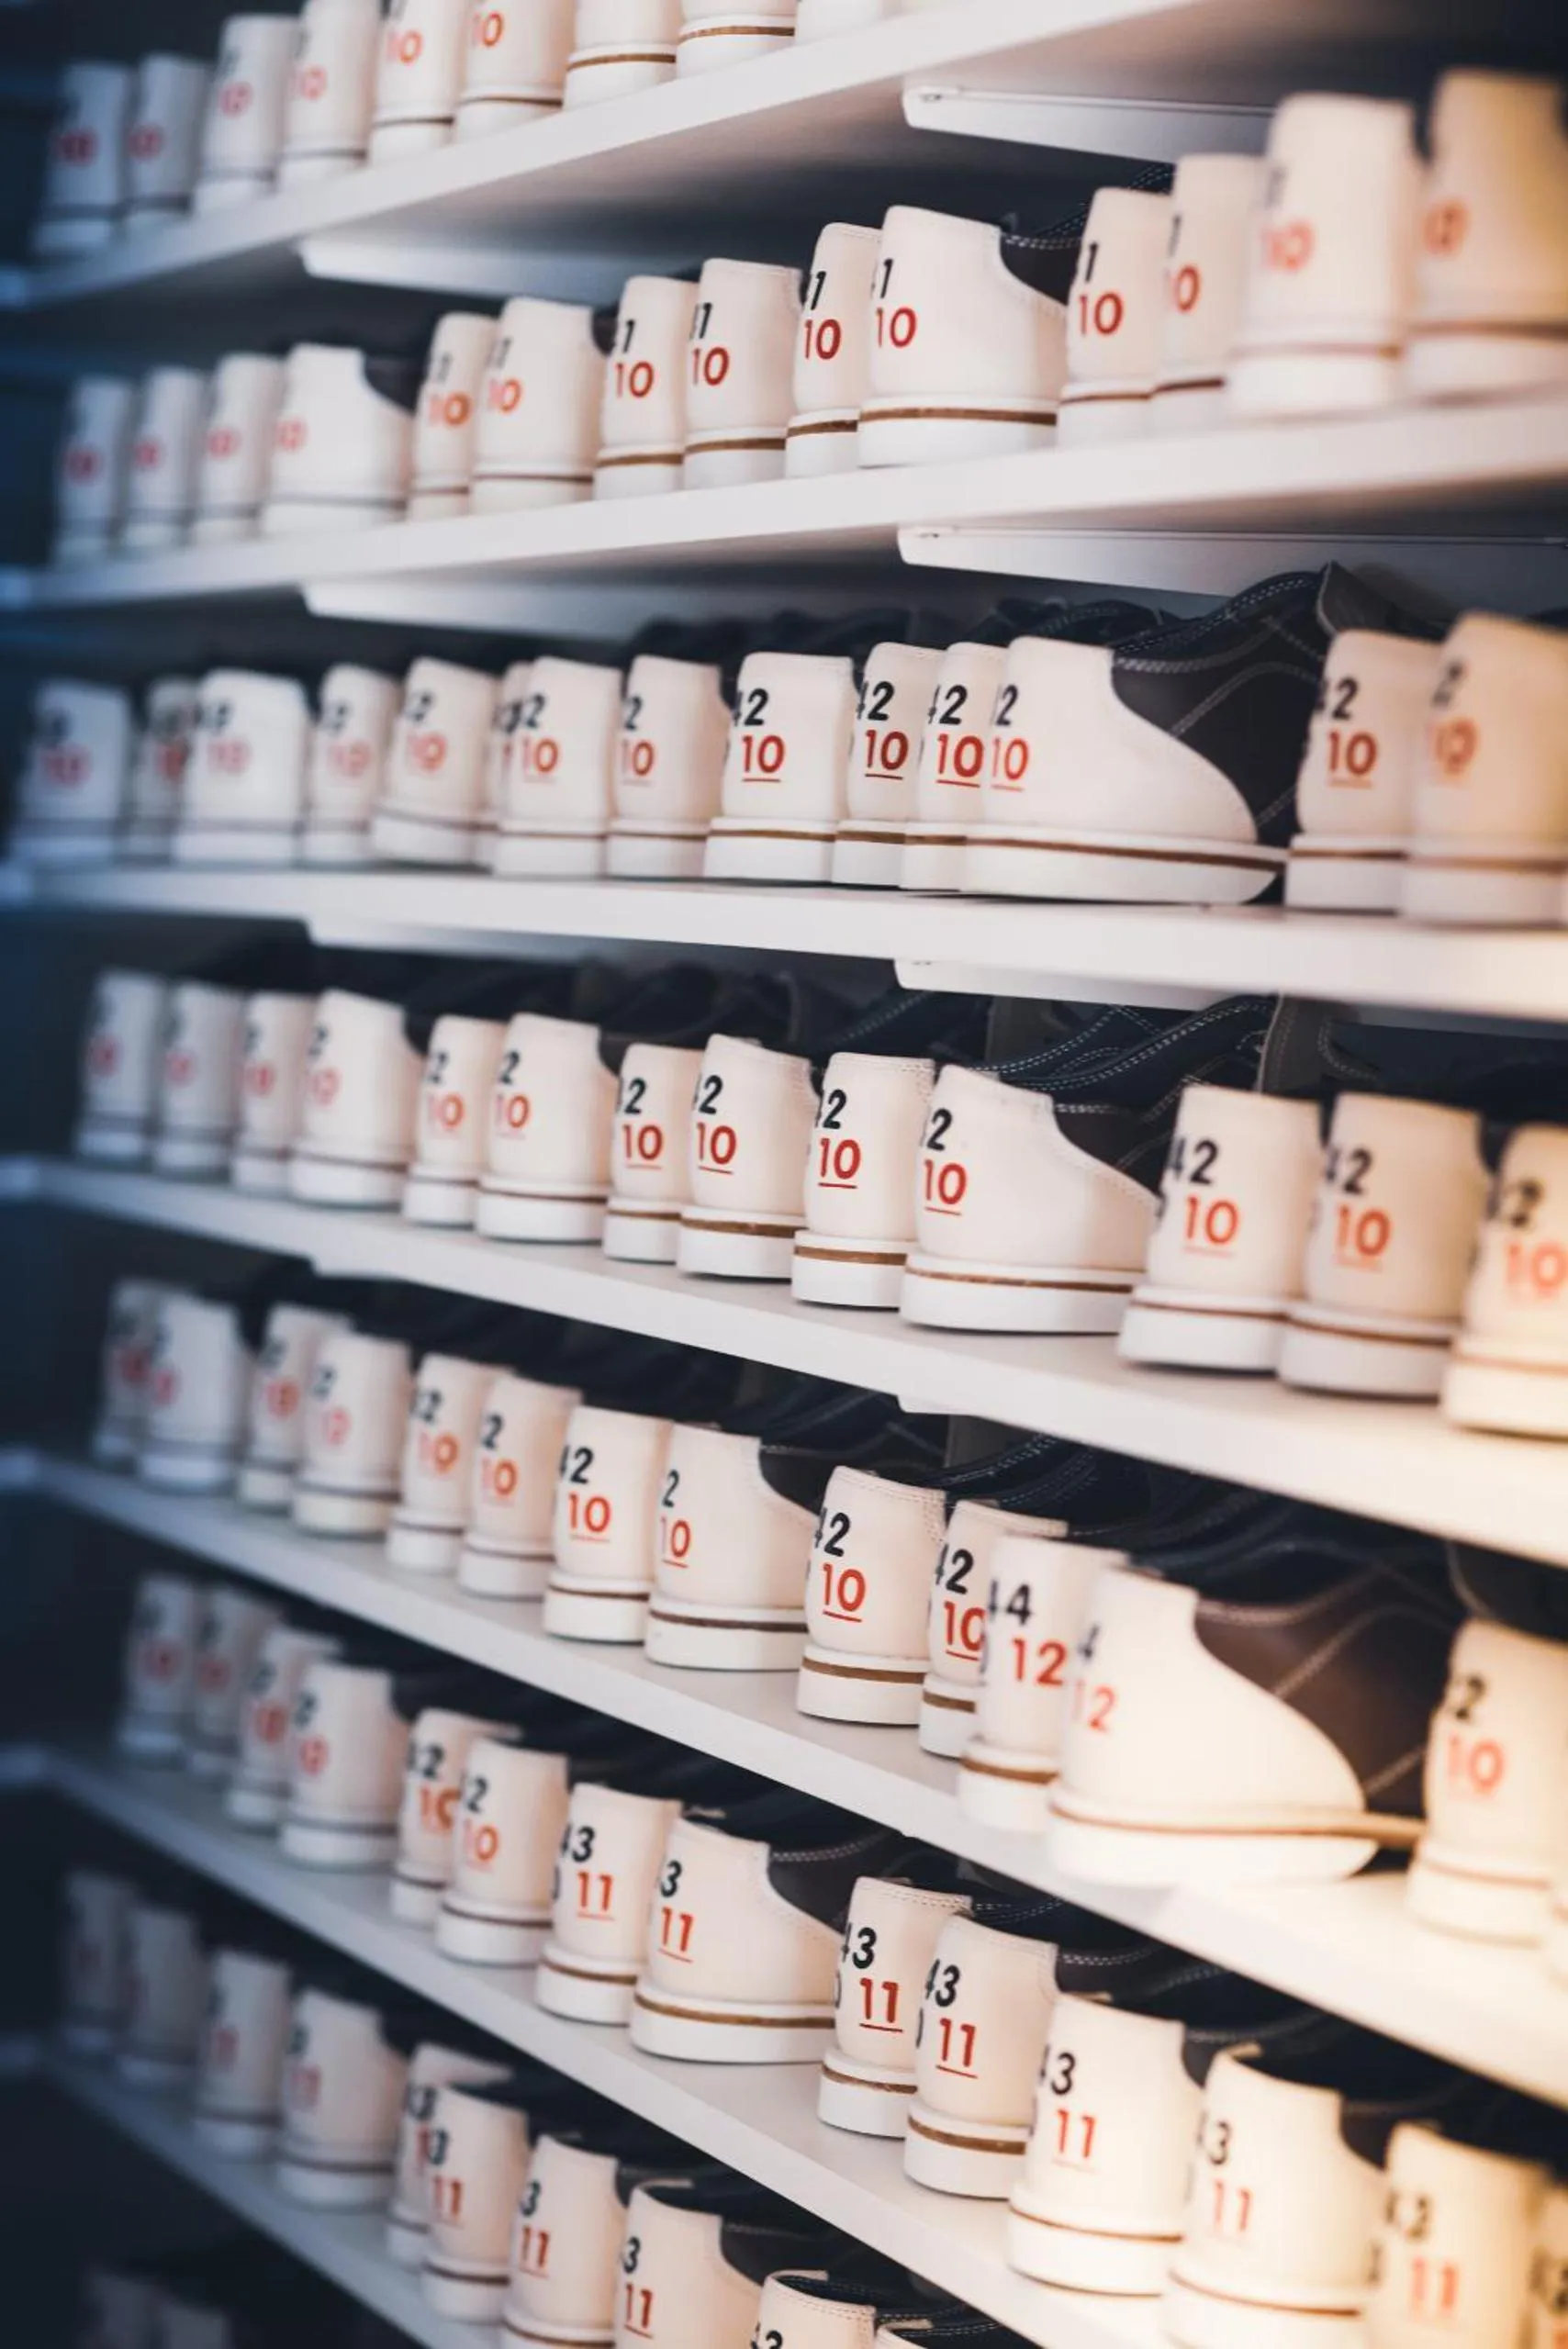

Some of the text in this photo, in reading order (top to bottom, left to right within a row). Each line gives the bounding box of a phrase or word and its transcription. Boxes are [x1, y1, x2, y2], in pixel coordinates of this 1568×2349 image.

[876, 307, 917, 348] 10
[1079, 292, 1123, 335] 10
[805, 319, 841, 360] 10
[616, 361, 654, 398] 10
[692, 347, 730, 386] 10
[742, 735, 785, 773] 10
[866, 730, 909, 770] 10
[937, 734, 984, 777] 10
[992, 738, 1028, 780] 10
[1327, 730, 1378, 776] 10
[623, 1124, 663, 1160] 10
[697, 1122, 737, 1165] 10
[820, 1137, 861, 1180] 10
[924, 1159, 968, 1204] 10
[1185, 1194, 1239, 1246] 10
[1337, 1203, 1392, 1257] 10
[569, 1492, 610, 1533] 10
[660, 1516, 690, 1558] 10
[823, 1563, 866, 1613] 10
[944, 1600, 986, 1652] 10
[1011, 1638, 1069, 1687] 12
[1449, 1733, 1504, 1793] 10
[577, 1871, 613, 1911] 11
[662, 1907, 693, 1952] 11
[860, 1977, 899, 2023] 11
[939, 2018, 976, 2067] 11
[1057, 2109, 1095, 2158] 11
[433, 2176, 464, 2217] 11
[1214, 2179, 1251, 2232] 11
[521, 2226, 549, 2268] 11
[626, 2283, 655, 2329] 11
[1412, 2256, 1459, 2313] 11
